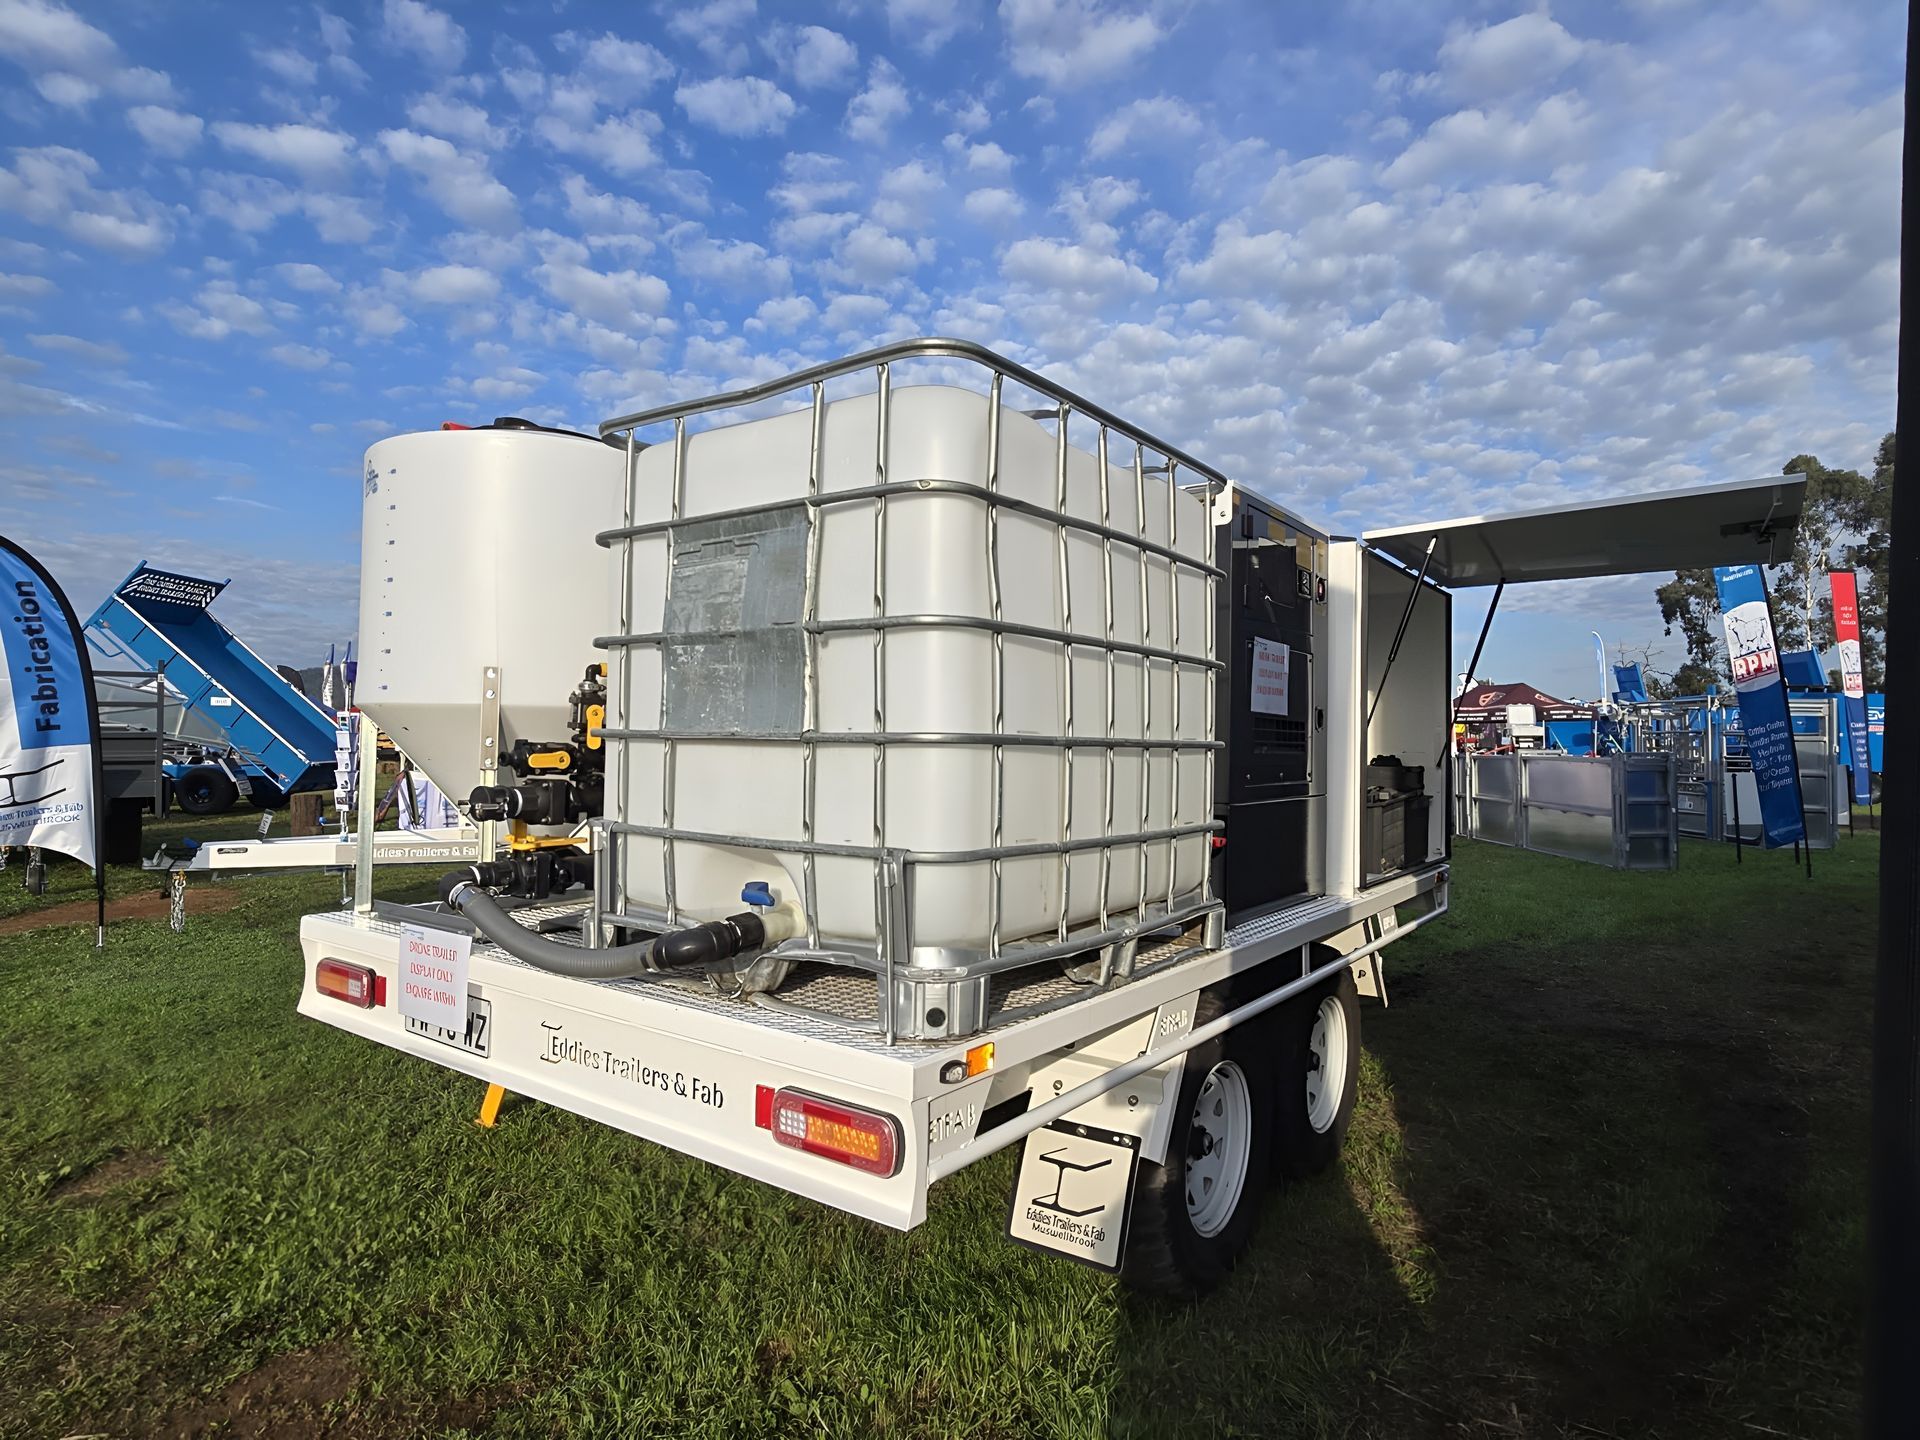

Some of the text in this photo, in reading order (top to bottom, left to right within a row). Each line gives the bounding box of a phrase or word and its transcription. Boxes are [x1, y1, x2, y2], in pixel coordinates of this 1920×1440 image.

[15, 581, 61, 732] Fabrication
[1735, 650, 1776, 676] RPM
[404, 847, 450, 858] Trailers
[451, 846, 460, 856] &
[409, 941, 430, 956] DRONE
[410, 962, 453, 983] DISPLAY ONLY
[552, 1036, 724, 1108] Eddies Trailers & Fab
[1026, 1207, 1106, 1242] Eddies Trailers & Fab
[1032, 1222, 1096, 1250] Muswellbrook
